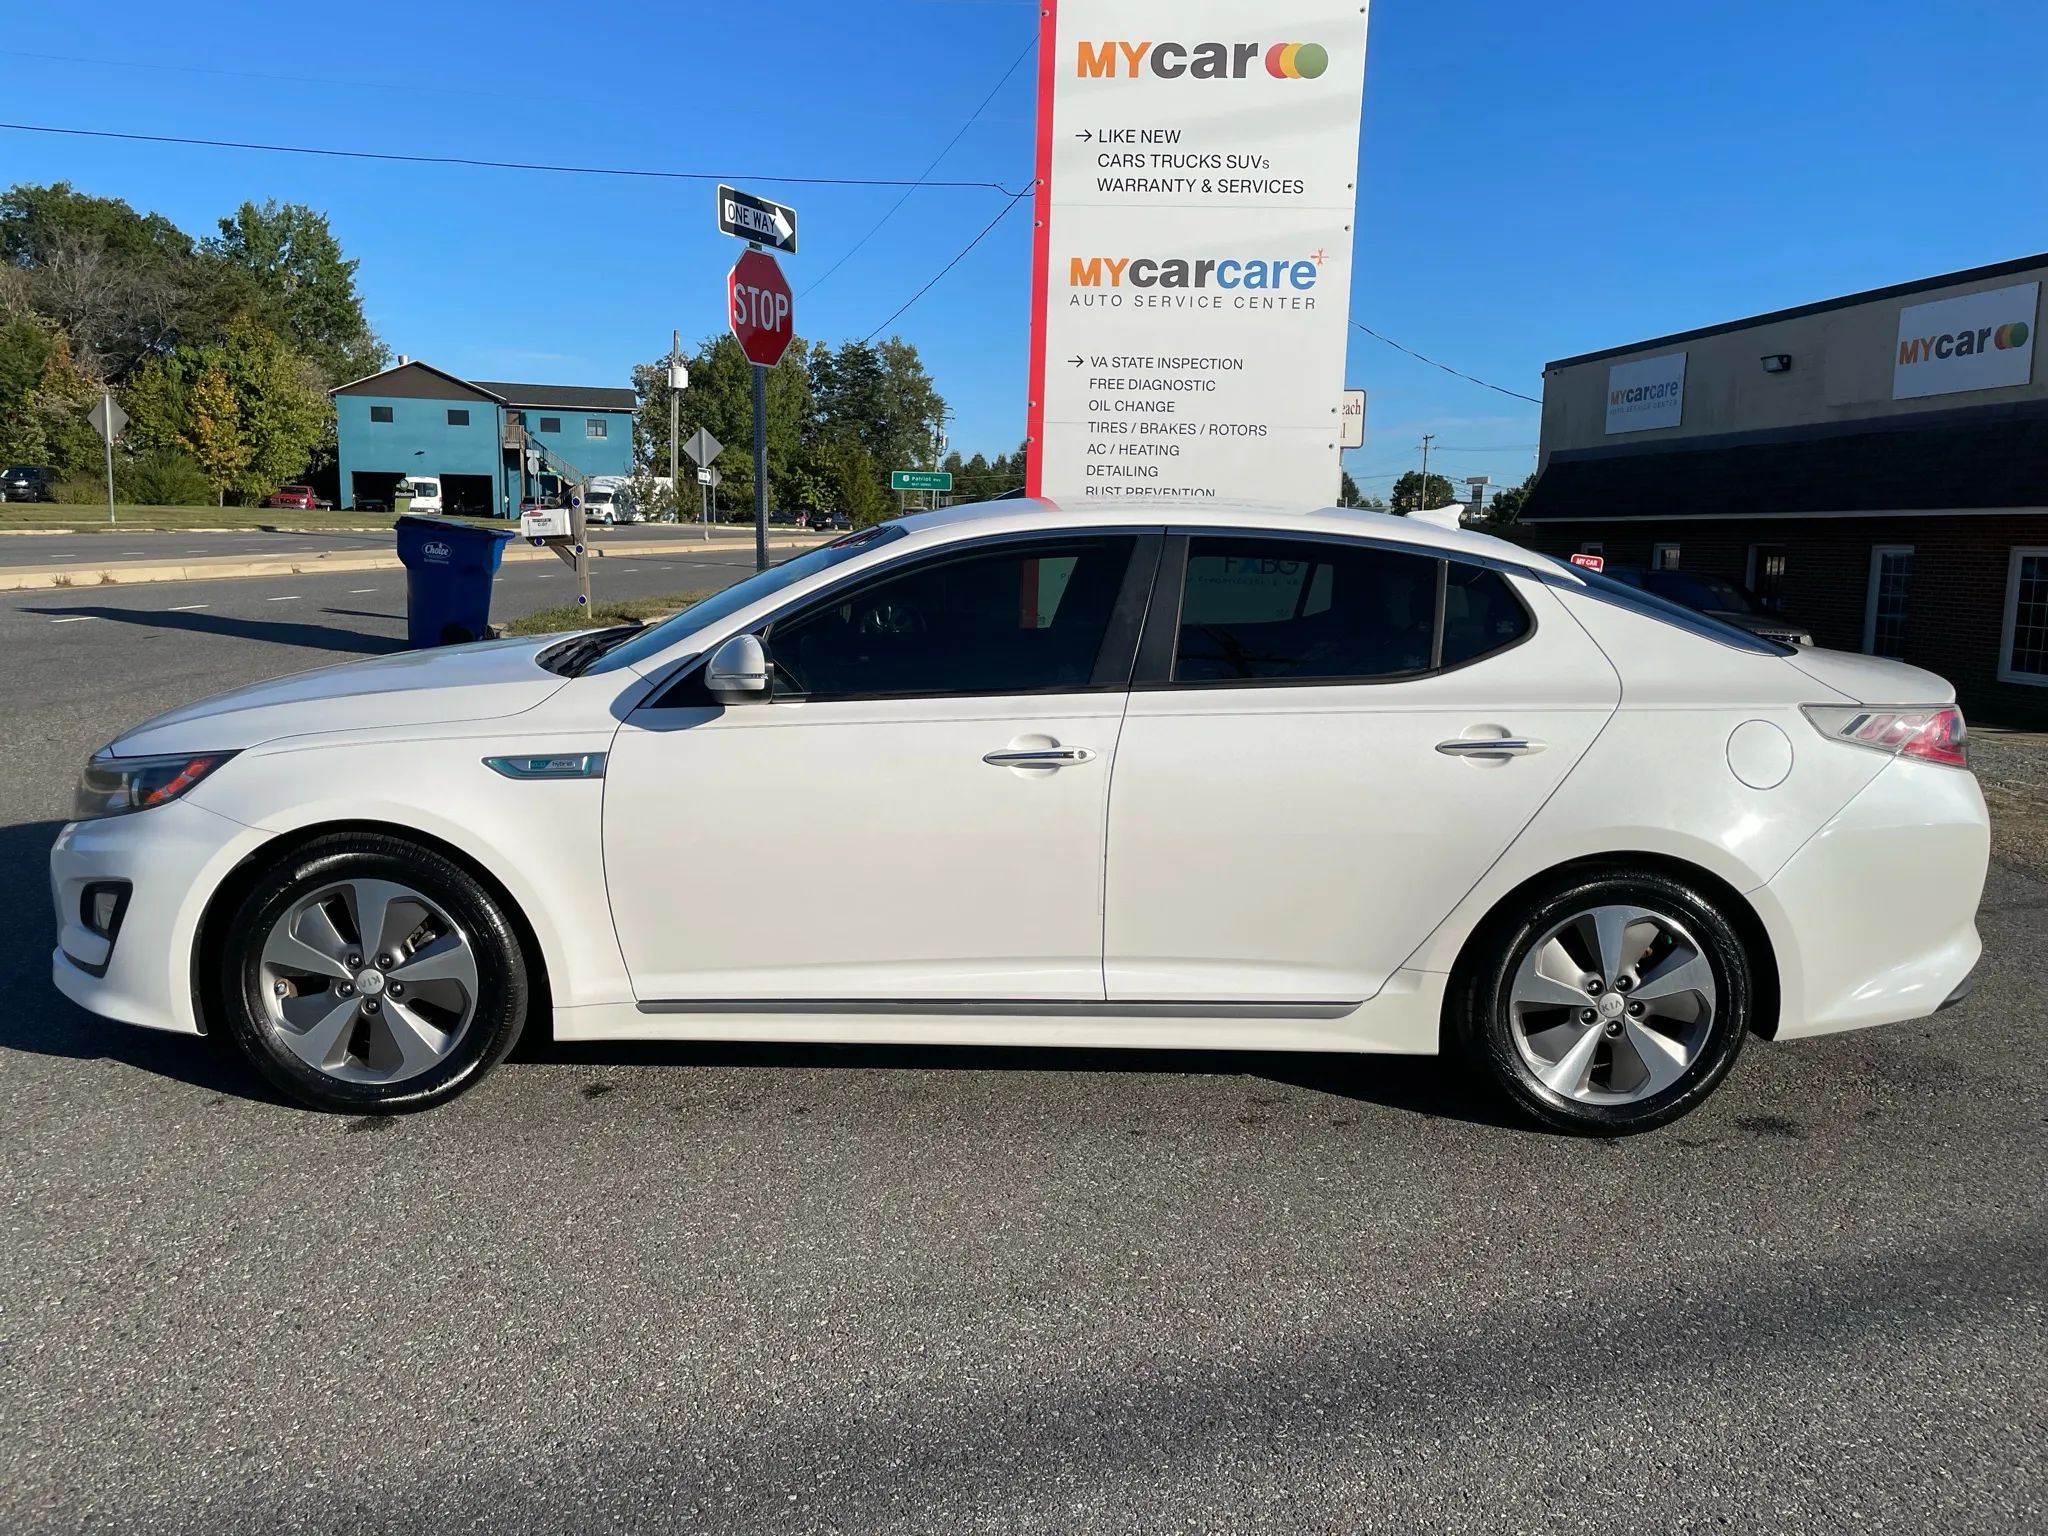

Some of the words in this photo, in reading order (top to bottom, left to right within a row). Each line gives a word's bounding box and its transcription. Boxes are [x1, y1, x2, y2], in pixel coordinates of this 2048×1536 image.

[1077, 41, 1259, 80] MYcar
[1098, 129, 1137, 144] LIKE
[1140, 129, 1182, 144] NEW
[1097, 153, 1146, 169] CARS
[1150, 153, 1222, 169] TRUCKS
[1096, 177, 1197, 193] WARRANTY
[1201, 179, 1213, 194] &
[1217, 179, 1304, 195] SERVICES
[728, 203, 750, 226] ONE
[752, 210, 776, 234] WAY
[1069, 256, 1318, 291] MYcarcare
[733, 283, 789, 333] STOP
[1069, 293, 1123, 307] AUTO
[1134, 294, 1223, 309] SERVICE
[1233, 296, 1316, 310] CENTER
[1899, 326, 1993, 366] MYcar
[1090, 355, 1109, 369] VA
[1112, 356, 1154, 369] STATE
[1157, 357, 1244, 371] INSPECTION
[1089, 377, 1125, 390] FREE
[1128, 378, 1217, 392] DIAGNOSTIC
[1610, 380, 1679, 406] MYcarcare
[1088, 399, 1111, 412] OIL
[1114, 400, 1176, 413] CHANGE
[1088, 421, 1128, 434] TIRES
[1130, 422, 1137, 434] /
[1140, 422, 1197, 436] BRAKES
[1199, 423, 1206, 435] /
[1208, 423, 1268, 437] ROTORS
[1086, 443, 1107, 455] AC
[1109, 443, 1116, 455] /
[1118, 443, 1180, 457] HEATING
[1086, 464, 1159, 478] DETAILING
[1085, 485, 1123, 496] RUST
[1125, 486, 1216, 497] PREVENTION
[424, 544, 449, 556] Choice
[1575, 557, 1586, 566] MY
[1586, 559, 1599, 567] CAR
[1600, 1000, 1622, 1012] KIA
